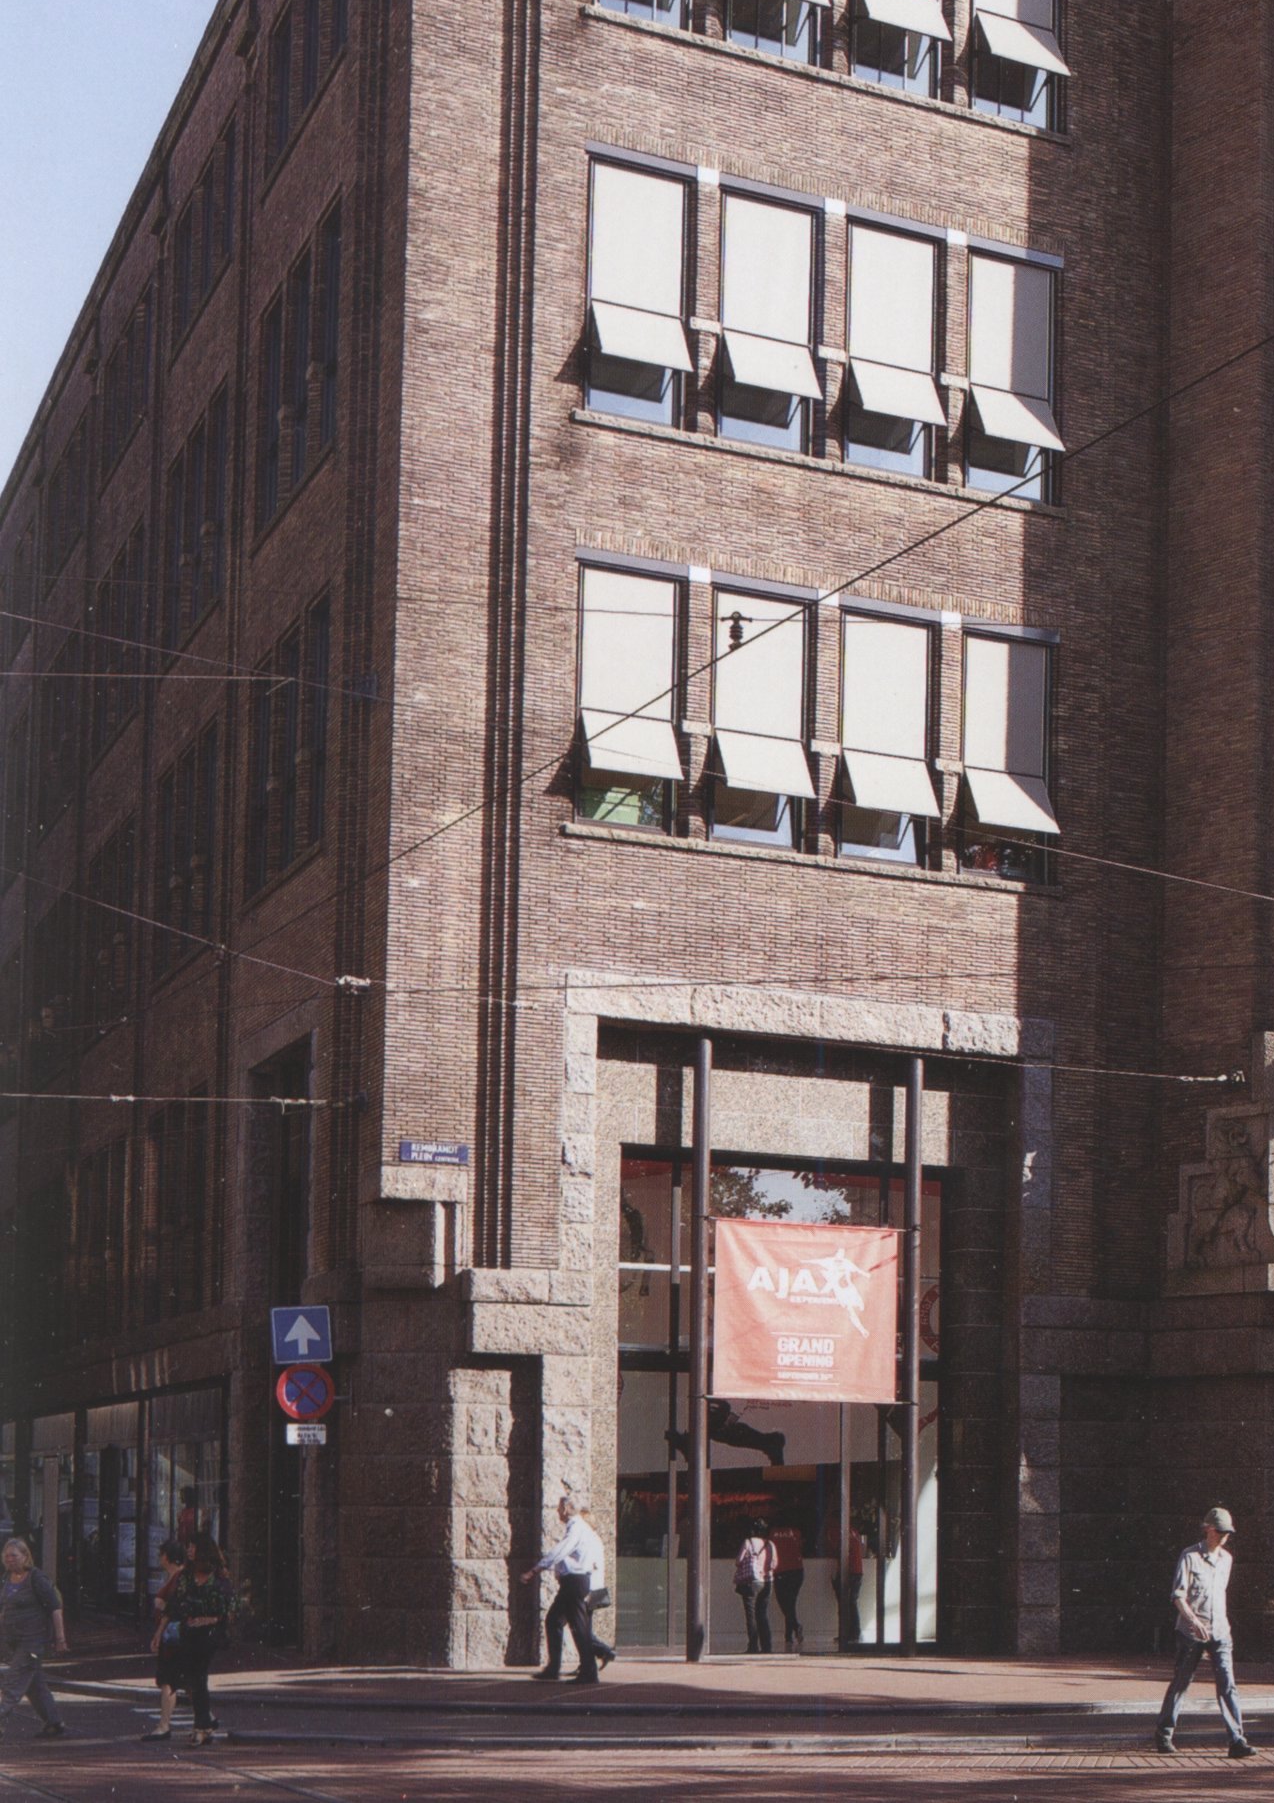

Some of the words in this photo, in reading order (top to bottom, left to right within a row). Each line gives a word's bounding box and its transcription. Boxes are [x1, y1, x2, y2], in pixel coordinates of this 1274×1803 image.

[747, 1265, 846, 1299] AJAX
[777, 1337, 834, 1354] GRAND
[777, 1354, 833, 1367] OPENING
